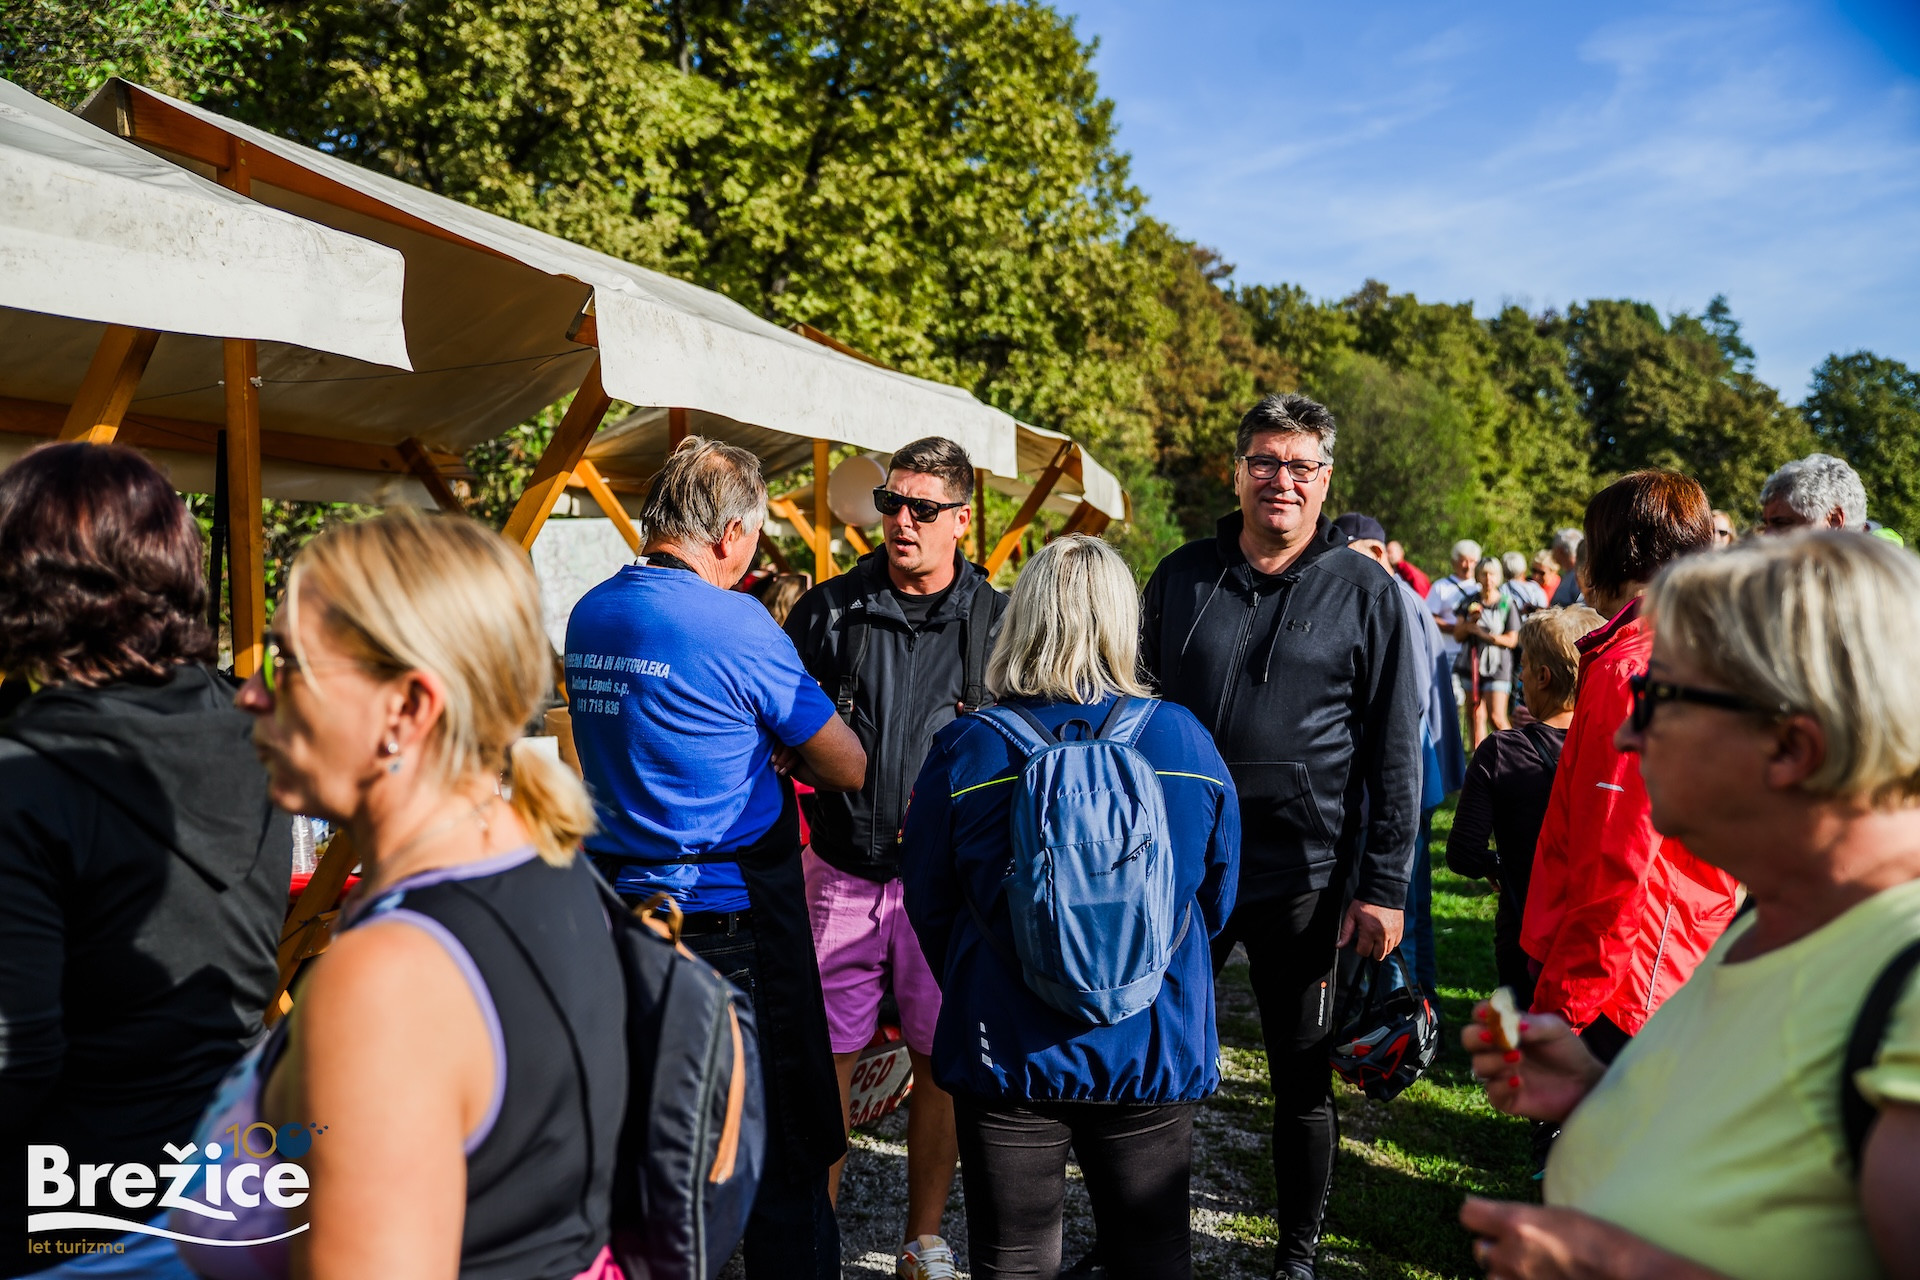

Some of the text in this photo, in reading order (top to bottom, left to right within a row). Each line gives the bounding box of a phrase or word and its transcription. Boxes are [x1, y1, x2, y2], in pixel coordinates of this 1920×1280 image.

[613, 655, 671, 679] AVTOVLEKA
[613, 682, 630, 697] s.p.
[850, 1052, 897, 1093] PGD
